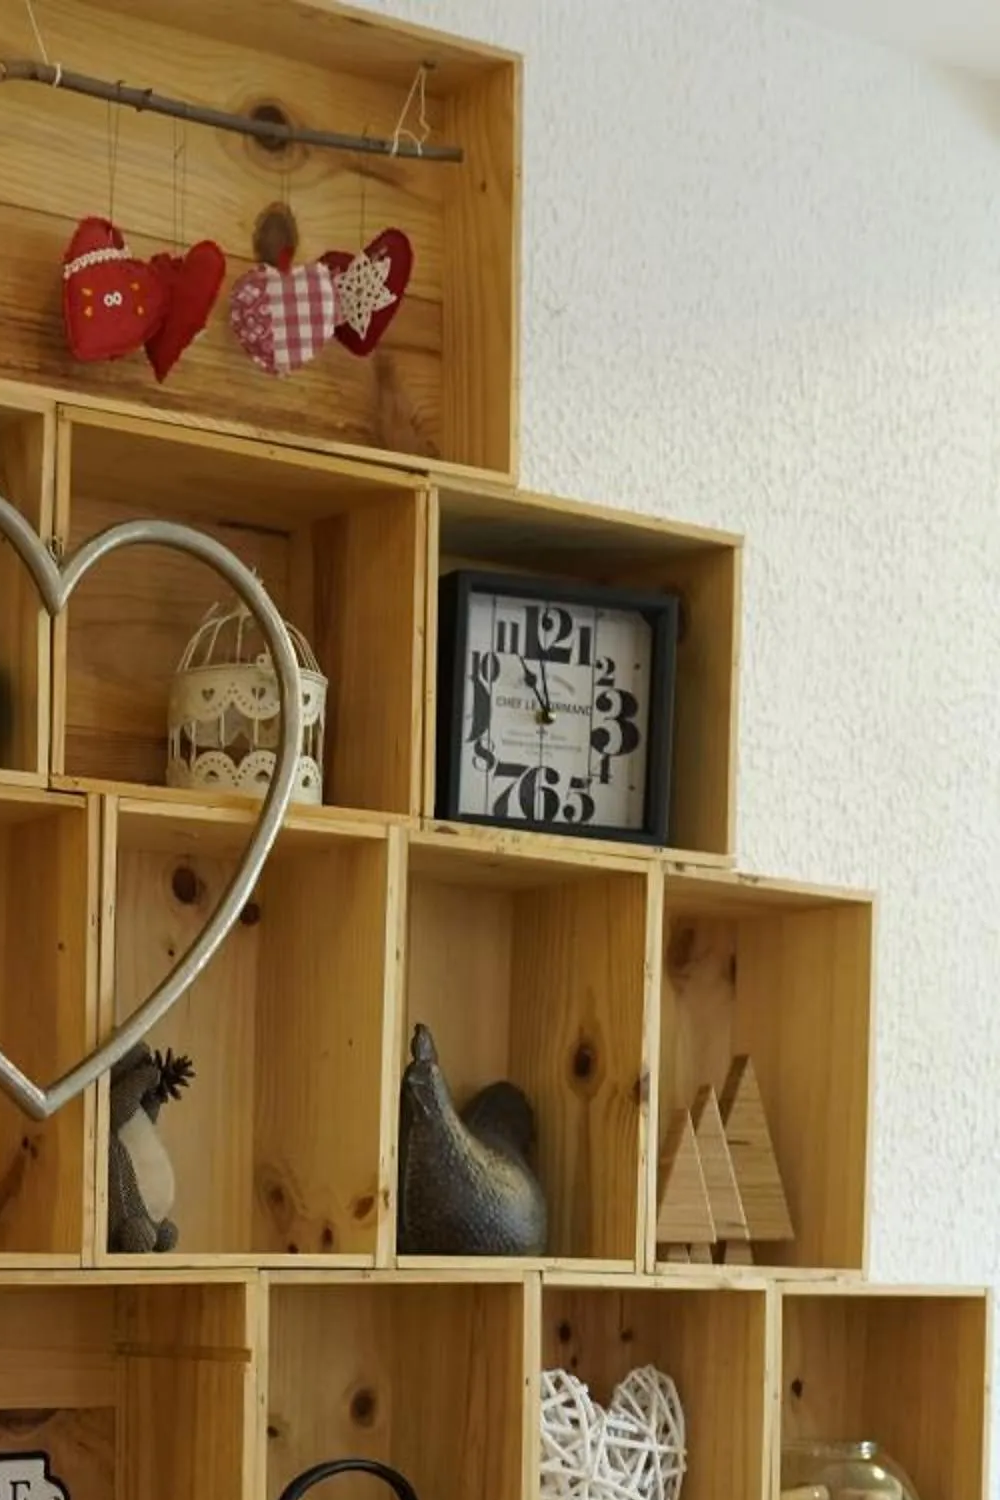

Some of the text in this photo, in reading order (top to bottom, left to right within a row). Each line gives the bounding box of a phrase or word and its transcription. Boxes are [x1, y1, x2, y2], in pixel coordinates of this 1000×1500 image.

[496, 605, 592, 666] 11 12 1
[595, 655, 616, 687] 2
[591, 688, 641, 757] 3
[472, 740, 495, 772] 8
[519, 766, 561, 821] 6
[563, 776, 595, 823] 5
